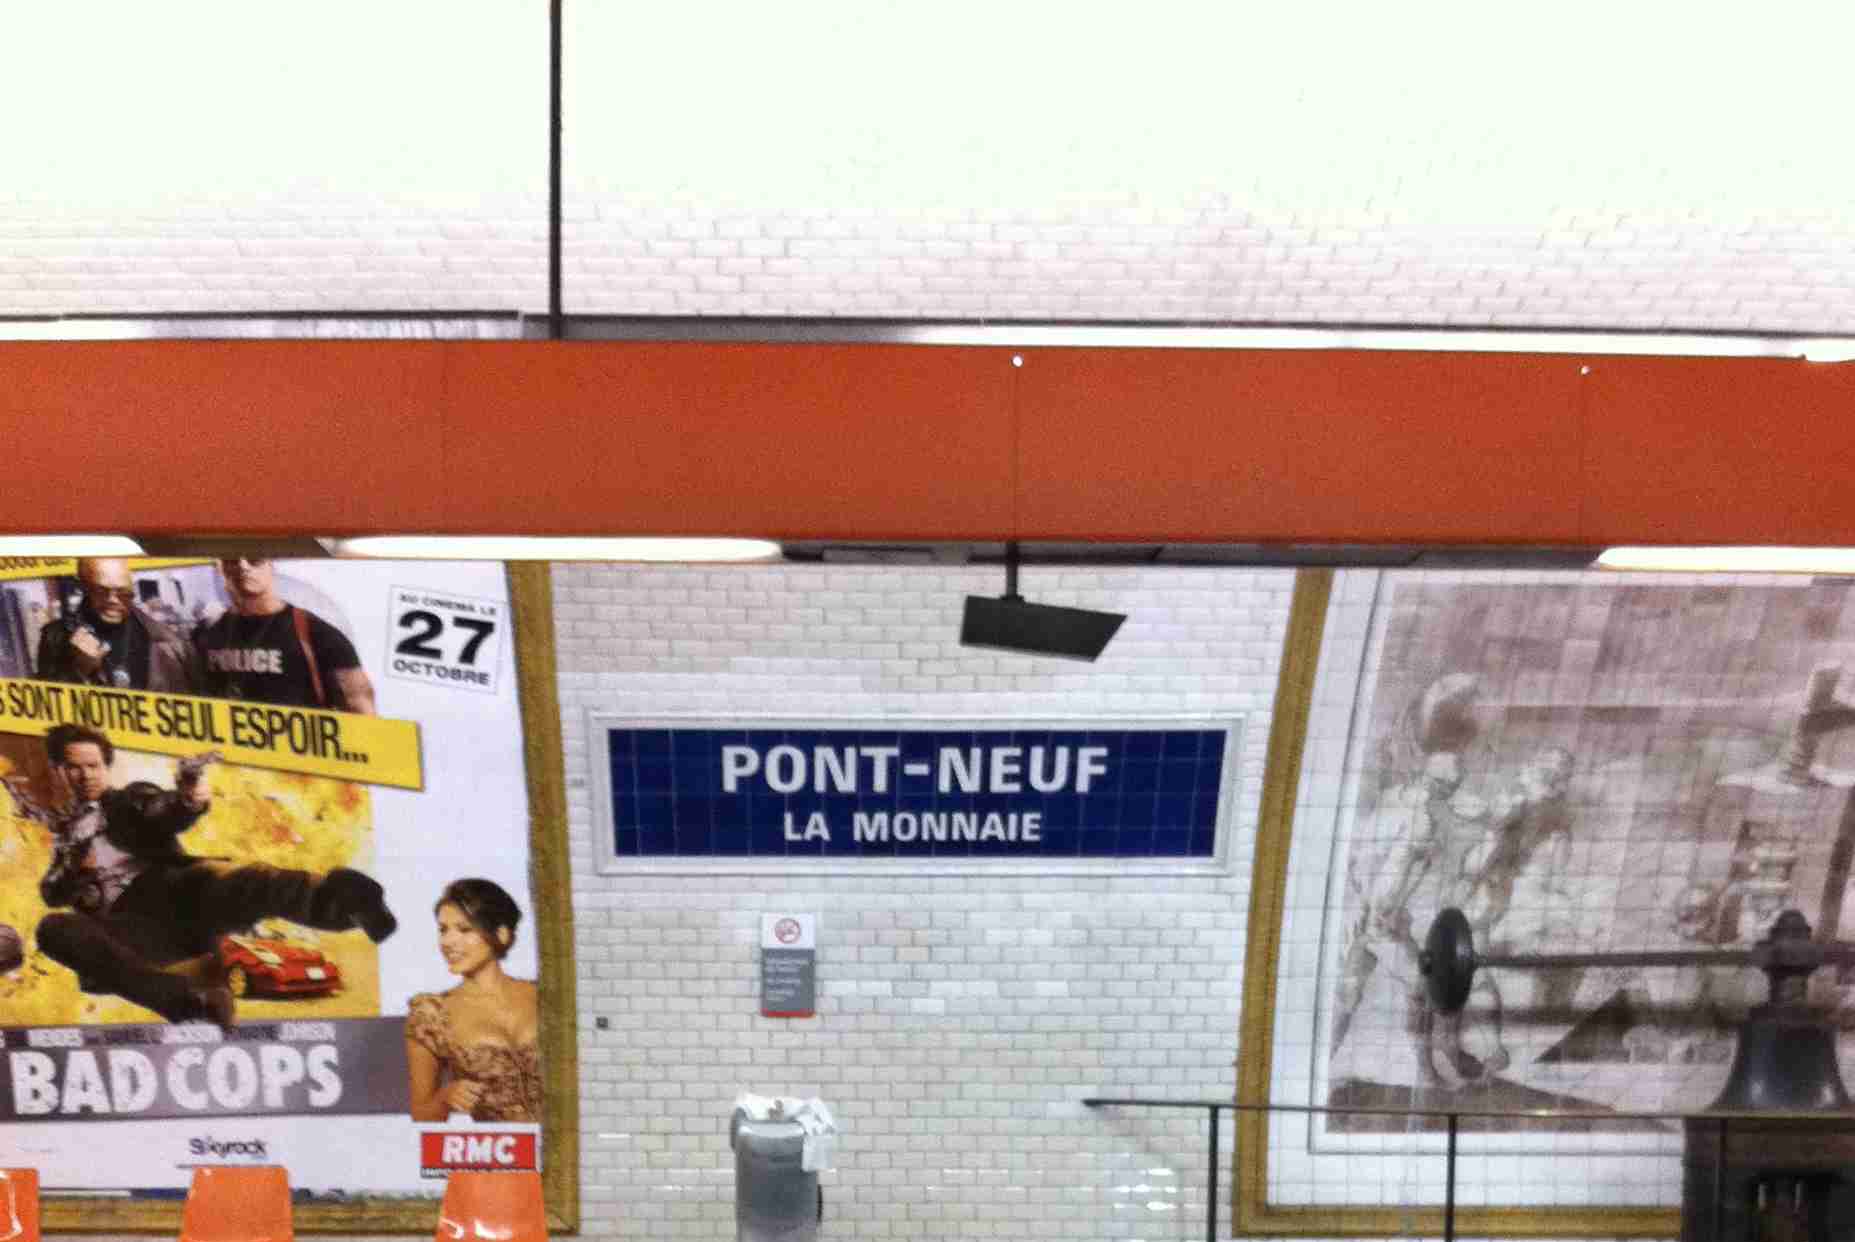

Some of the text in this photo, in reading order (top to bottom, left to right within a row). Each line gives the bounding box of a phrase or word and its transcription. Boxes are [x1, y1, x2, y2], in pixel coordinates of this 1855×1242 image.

[396, 609, 495, 665] 27
[208, 648, 284, 674] POLICE
[393, 659, 489, 686] OCTOBRE
[8, 681, 66, 724] SONT
[69, 688, 152, 736] NOTRE
[156, 697, 224, 744] SEUL
[229, 705, 369, 764] ESPOIR...
[721, 744, 1108, 794] PONT-NEUF
[783, 811, 1042, 842] LA MONNAIE
[9, 1044, 343, 1115] BAD COPS
[442, 1135, 517, 1164] RMC
